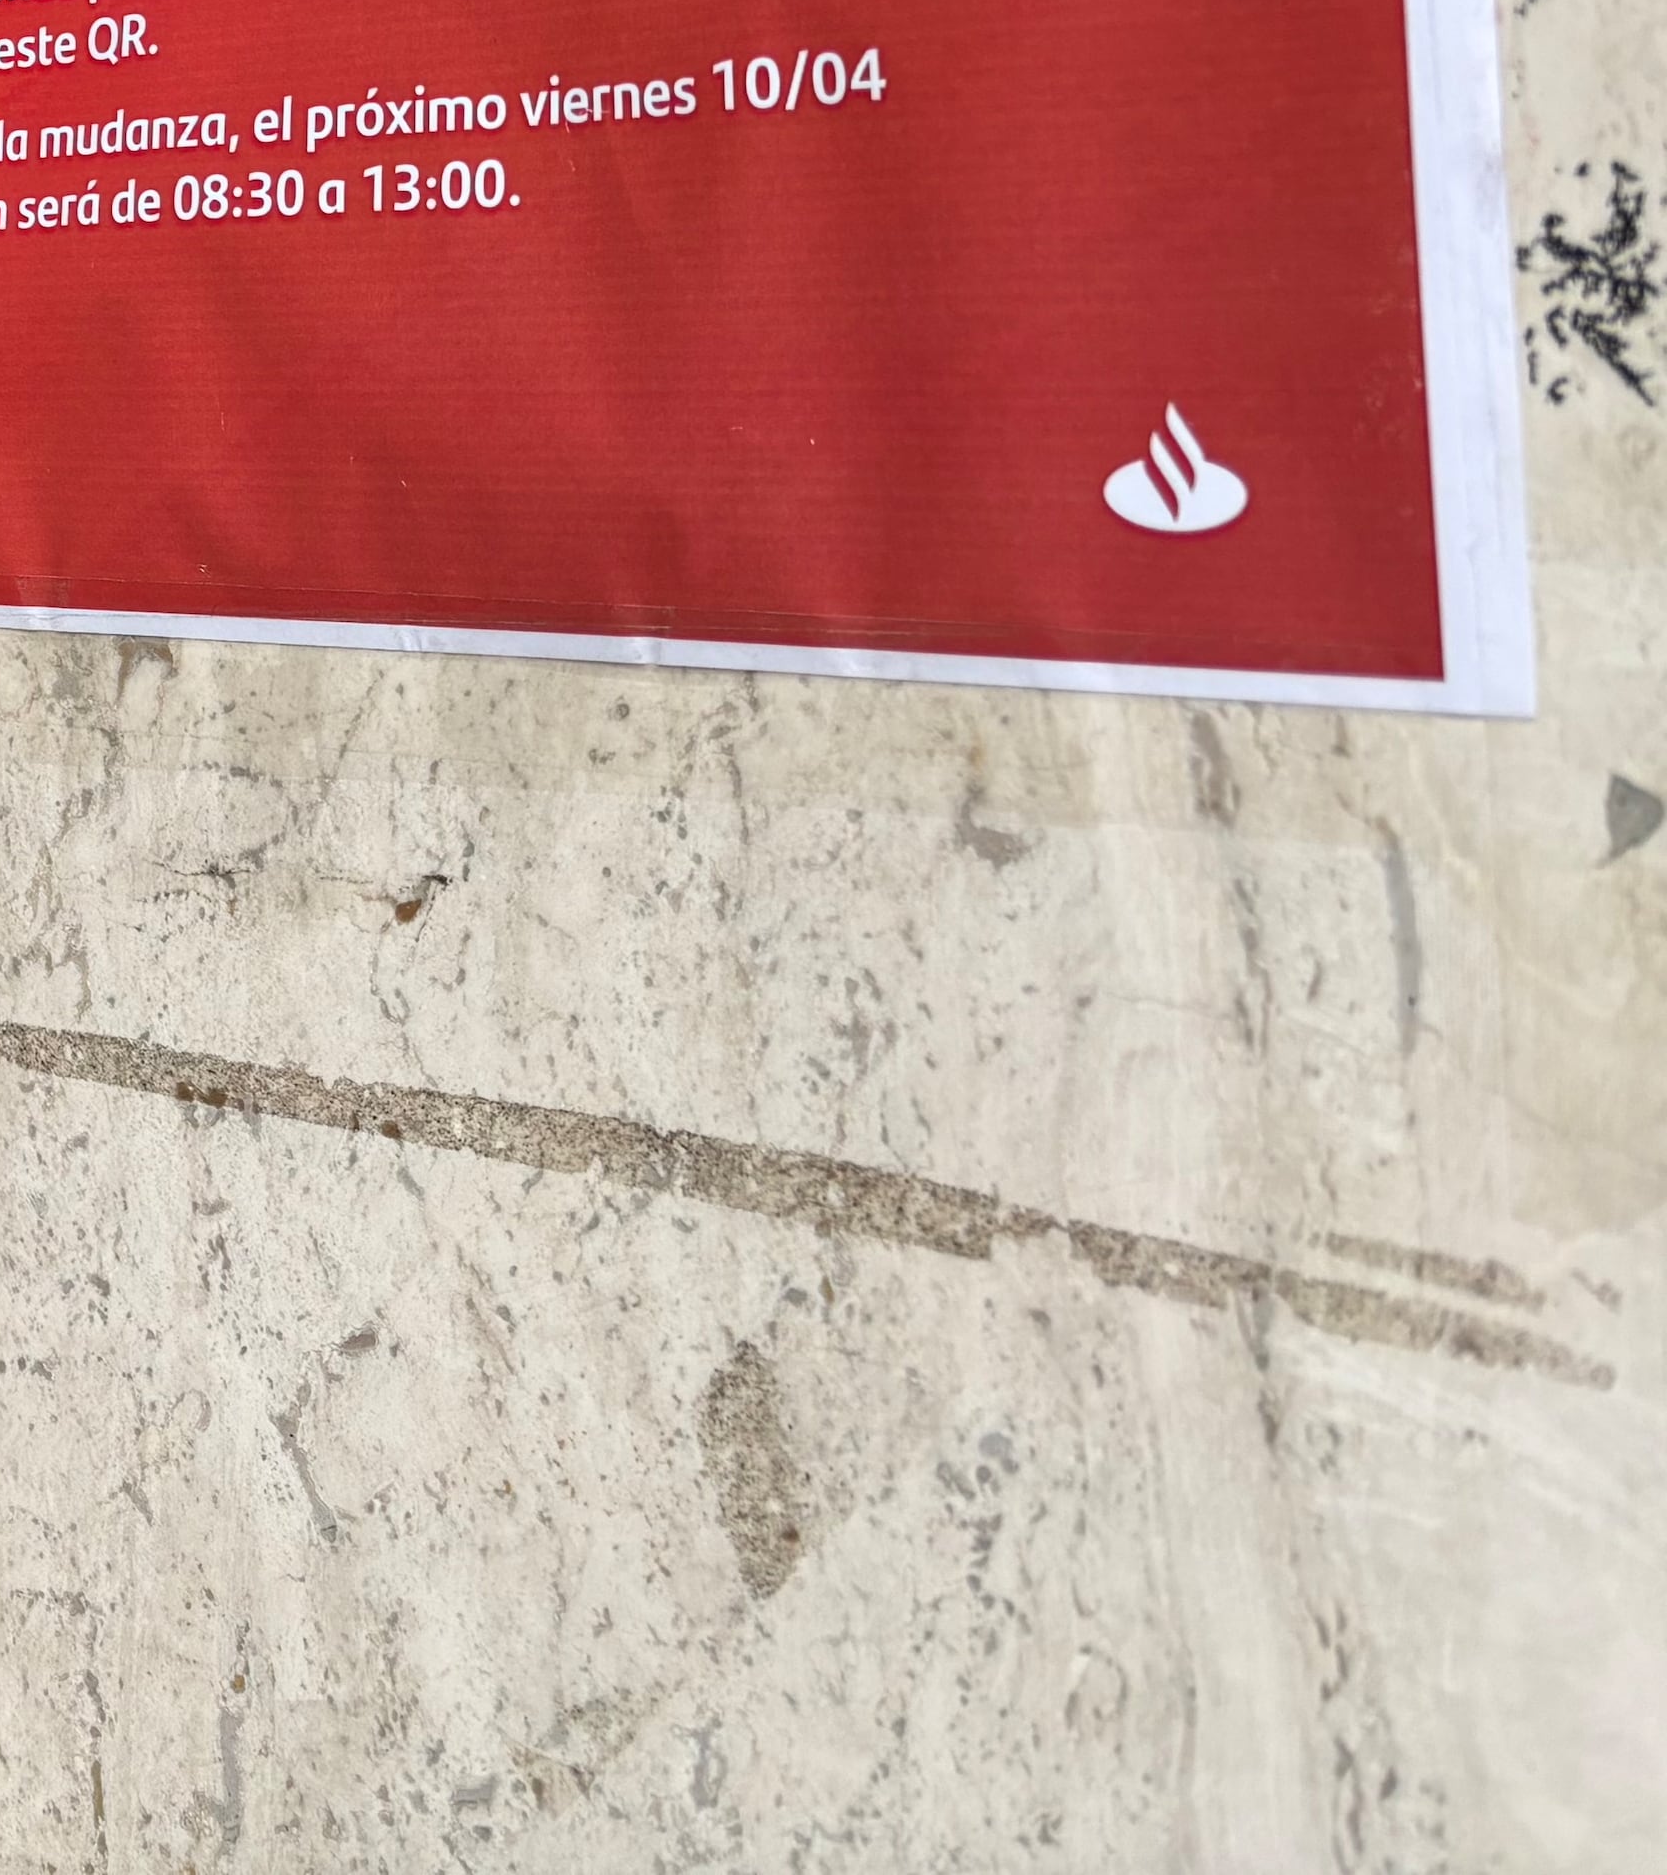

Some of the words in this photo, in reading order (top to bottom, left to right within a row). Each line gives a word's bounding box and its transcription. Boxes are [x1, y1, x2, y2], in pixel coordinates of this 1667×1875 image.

[87, 13, 159, 65] QR.
[39, 108, 239, 159] mudanza,
[253, 95, 293, 143] el
[306, 84, 507, 153] próximo
[519, 74, 697, 127] viernes
[712, 48, 887, 111] 10/04
[17, 179, 100, 229] será
[111, 178, 161, 224] de
[173, 169, 305, 221] 08:30
[318, 179, 346, 214] a
[363, 158, 521, 212] 13:00.
